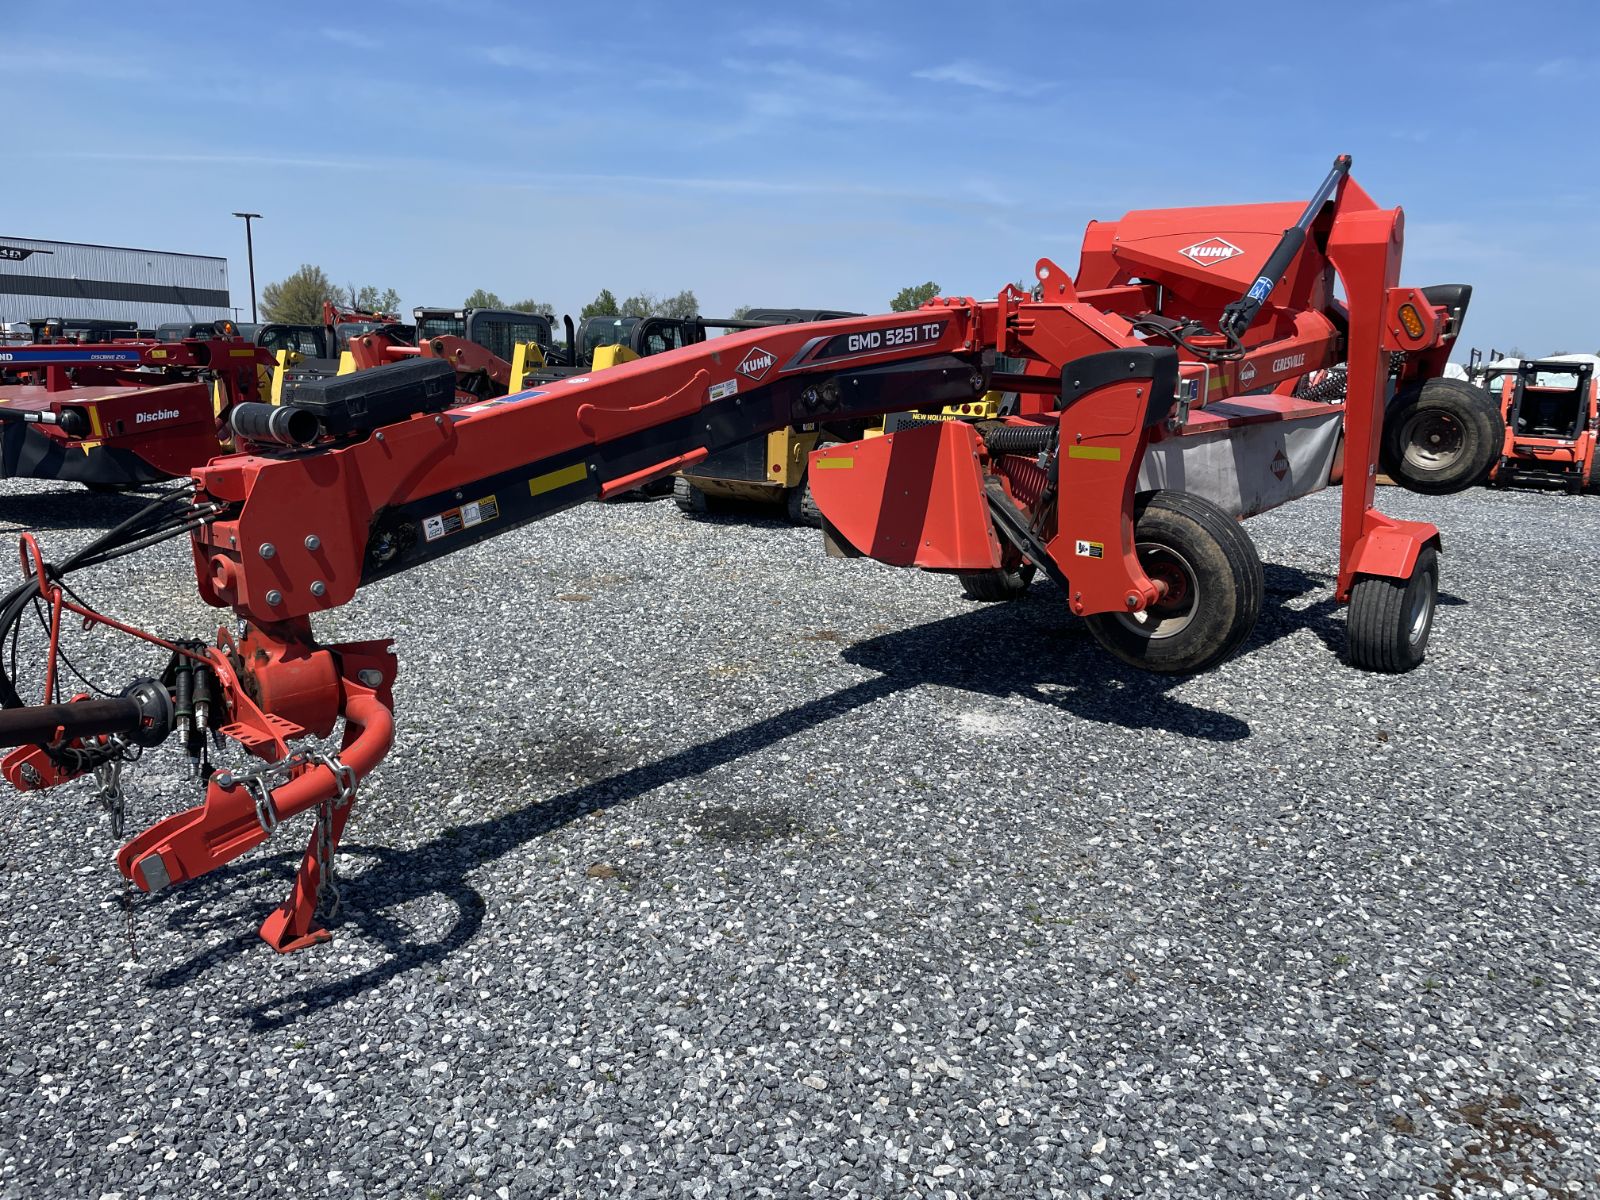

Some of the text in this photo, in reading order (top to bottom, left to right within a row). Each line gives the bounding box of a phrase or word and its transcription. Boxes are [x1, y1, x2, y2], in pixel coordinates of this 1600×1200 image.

[1189, 246, 1234, 258] KUHN
[848, 323, 940, 352] GMD 5251 TC
[742, 355, 772, 374] KUHN
[1272, 353, 1305, 373] CERESVILLE
[1240, 369, 1256, 380] KUHN
[136, 409, 180, 424] Discbine
